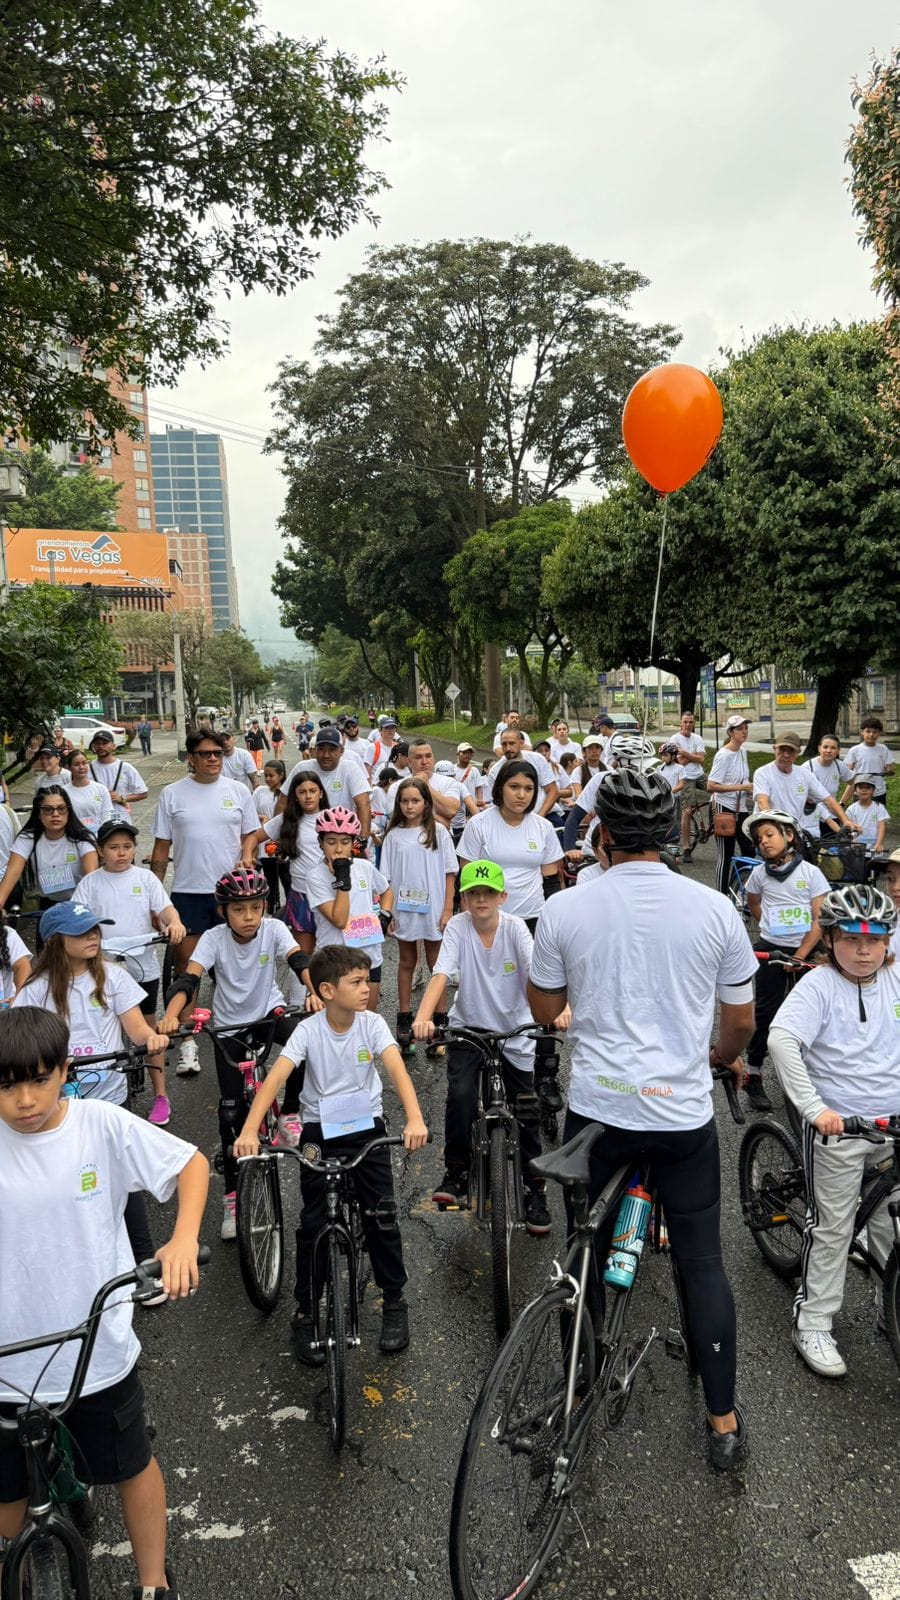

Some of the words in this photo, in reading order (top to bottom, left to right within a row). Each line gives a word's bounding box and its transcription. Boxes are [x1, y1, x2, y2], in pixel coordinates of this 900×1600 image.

[38, 547, 66, 561] Las
[70, 548, 121, 566] Vegas
[597, 1075, 638, 1095] REGGIO
[641, 1085, 673, 1096] EMILIA
